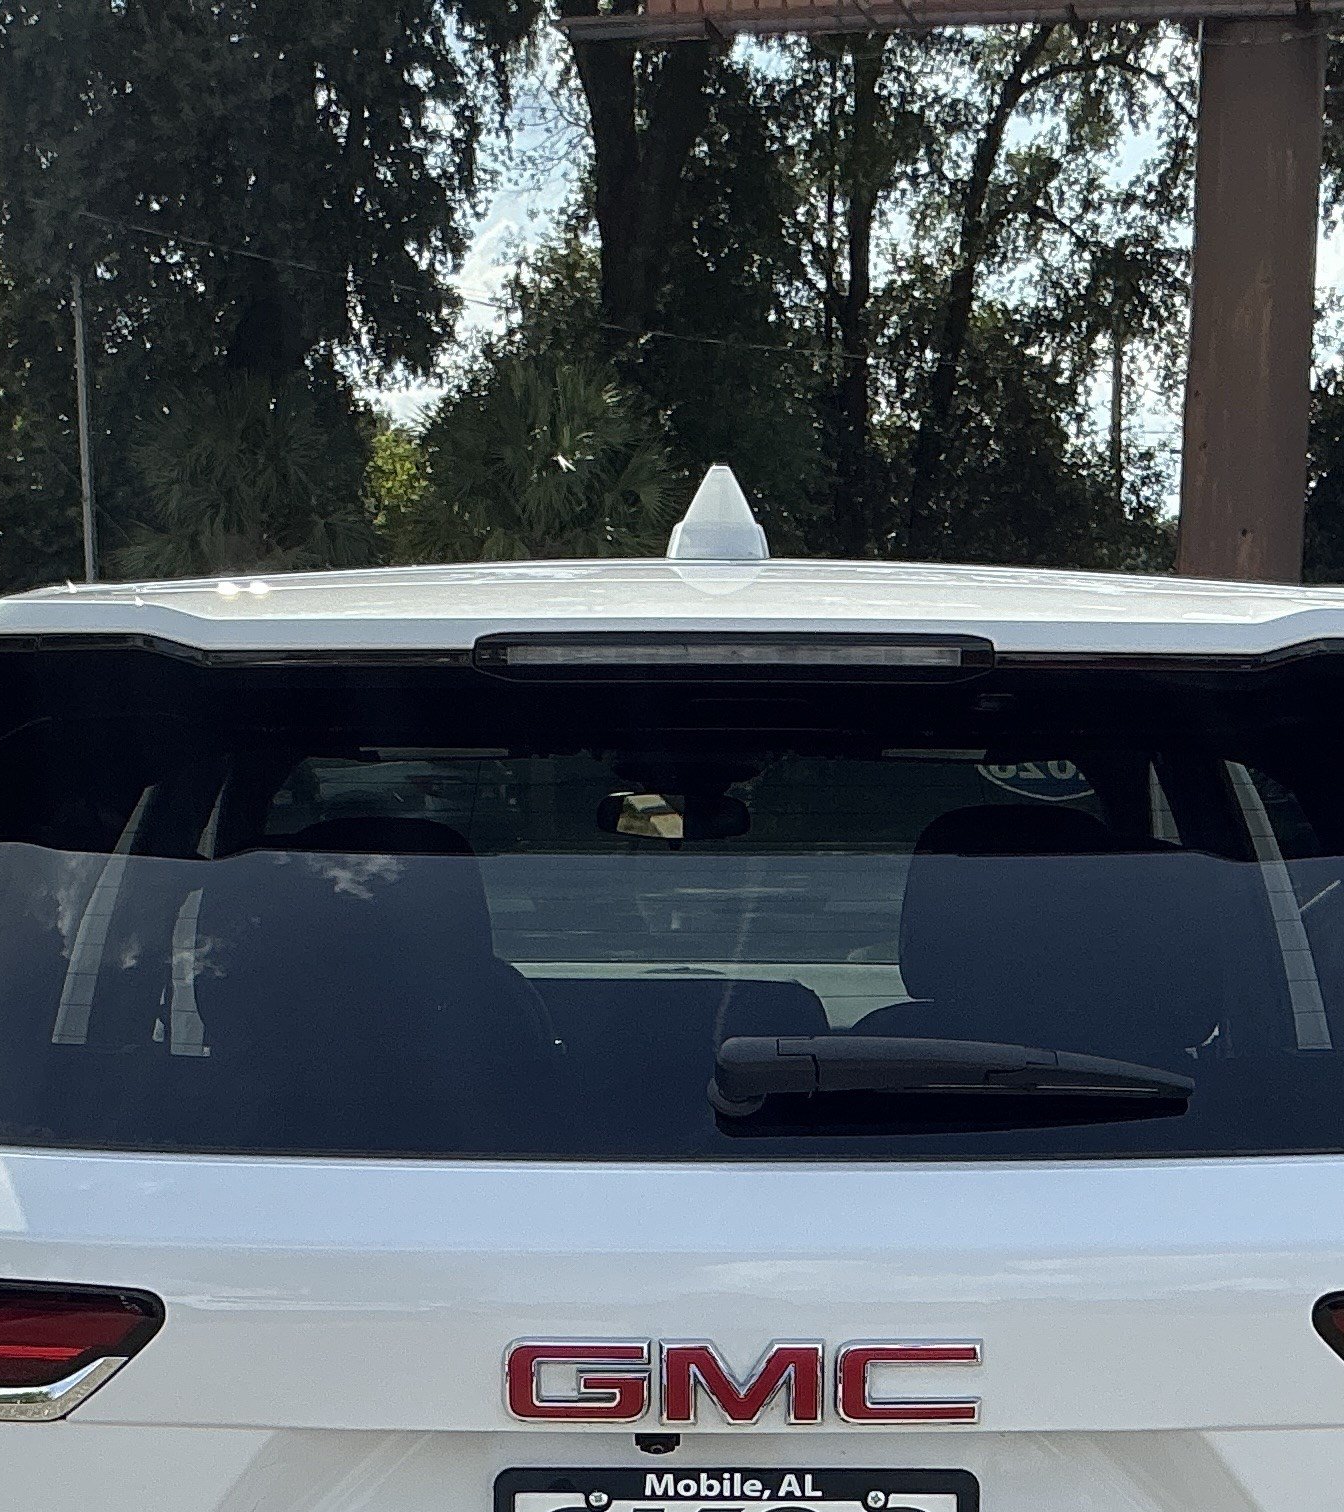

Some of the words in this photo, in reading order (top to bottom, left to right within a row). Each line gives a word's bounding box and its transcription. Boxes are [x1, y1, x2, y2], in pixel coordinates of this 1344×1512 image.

[506, 1338, 982, 1423] GMC
[644, 1474, 772, 1499] Mobile,
[777, 1474, 823, 1497] AL
